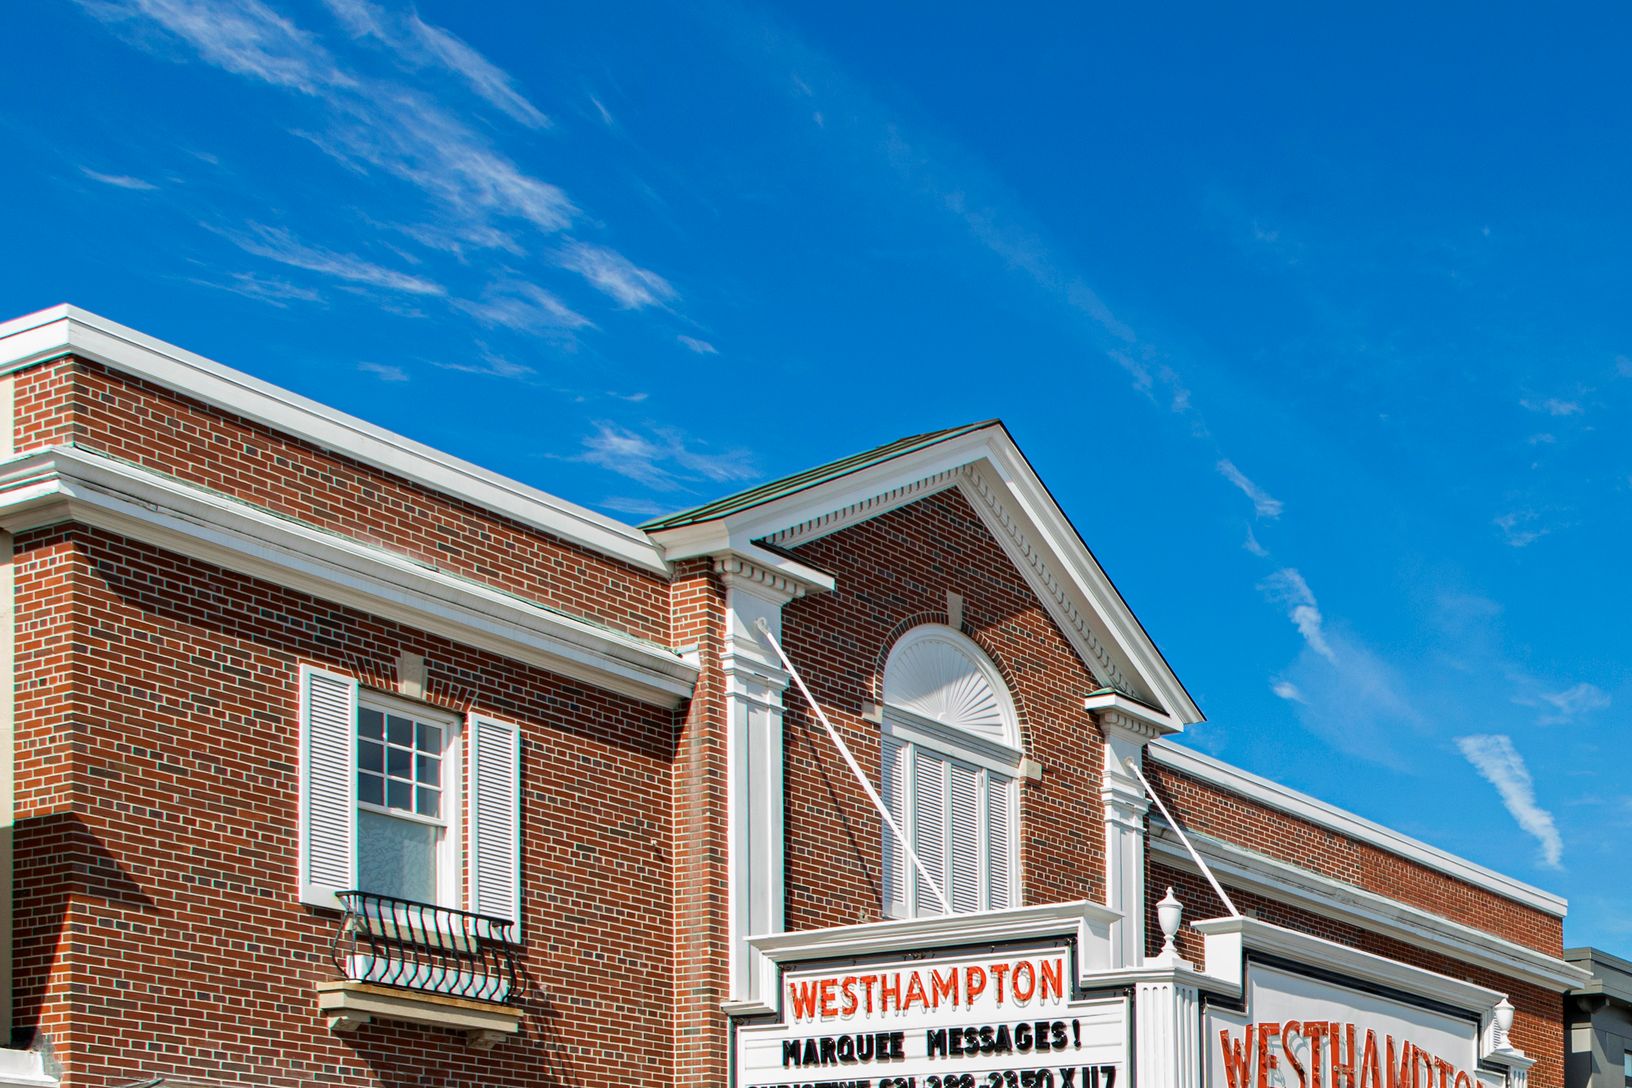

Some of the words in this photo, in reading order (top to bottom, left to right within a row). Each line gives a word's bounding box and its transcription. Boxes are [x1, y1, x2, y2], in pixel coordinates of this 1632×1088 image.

[789, 958, 1063, 1020] WESTHAMPTON
[782, 1031, 904, 1066] MARQUEE
[927, 1019, 1082, 1057] MESSAGES!
